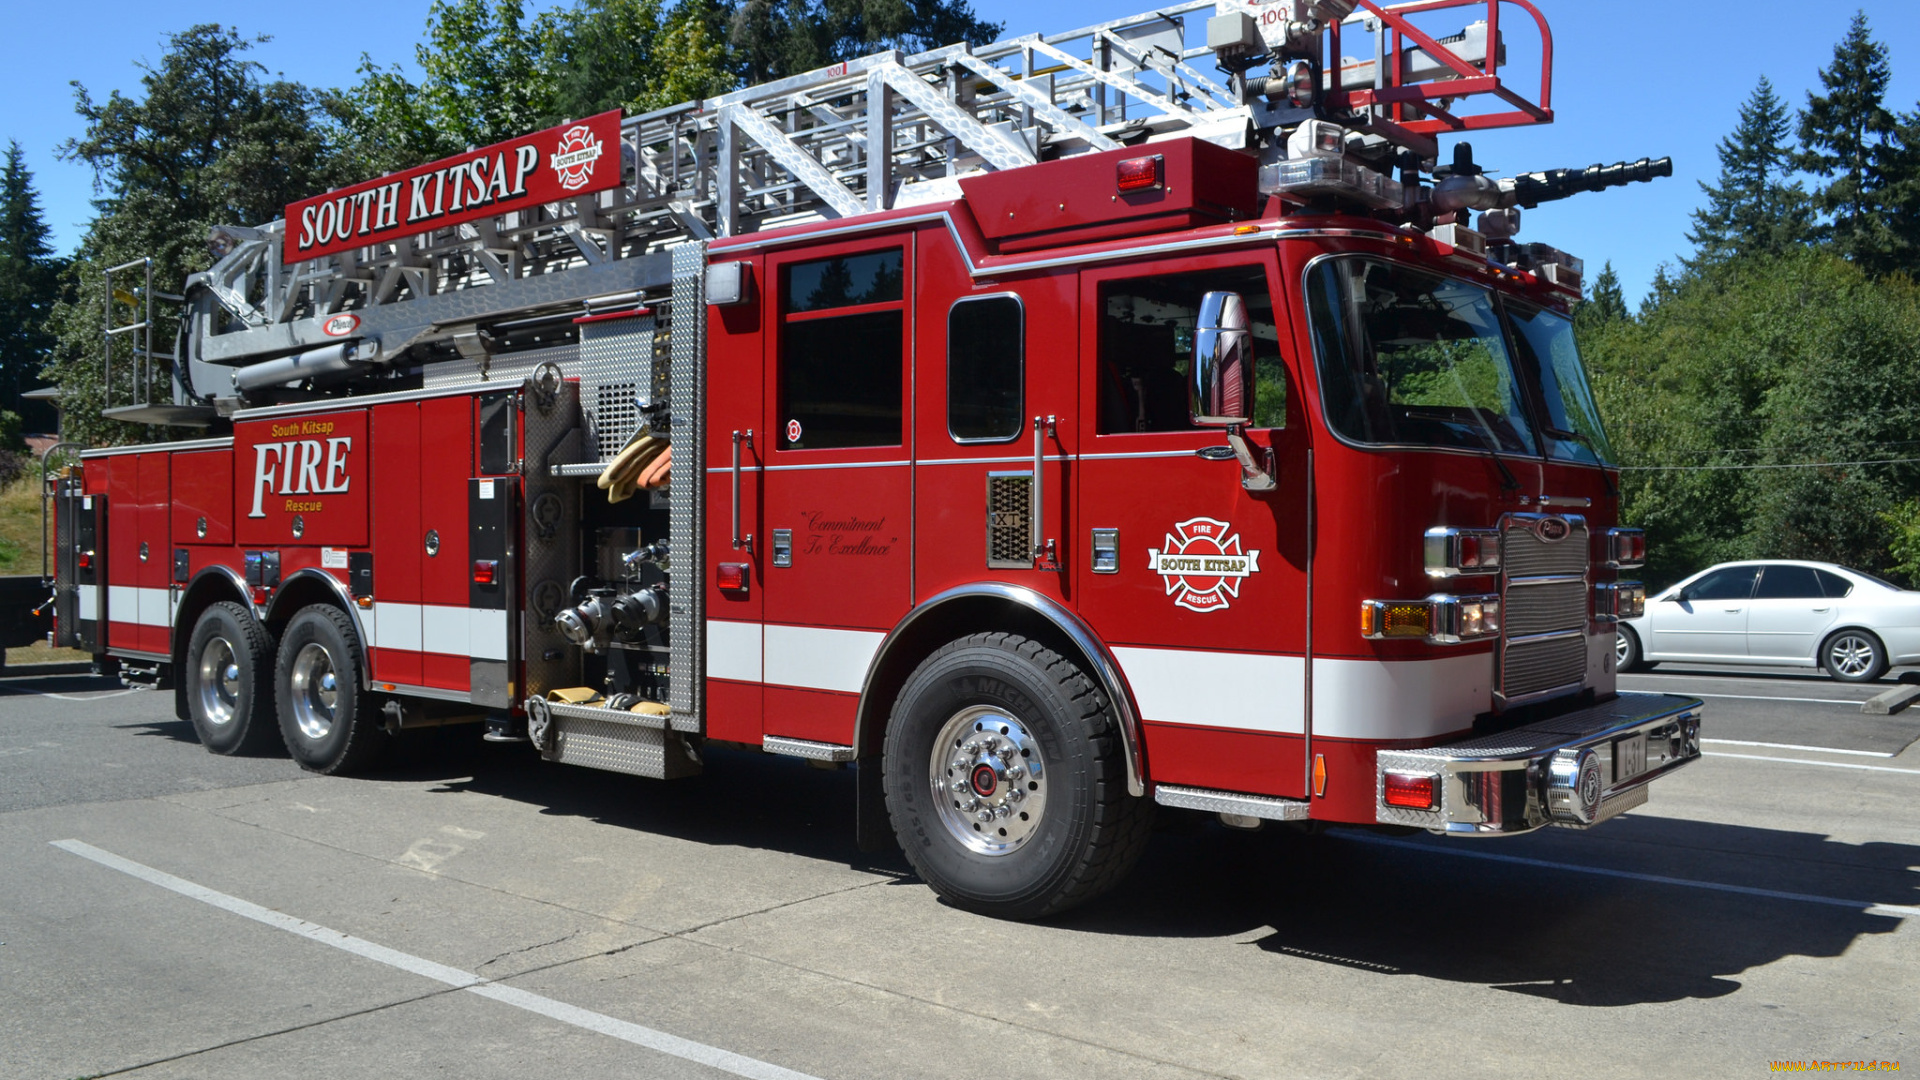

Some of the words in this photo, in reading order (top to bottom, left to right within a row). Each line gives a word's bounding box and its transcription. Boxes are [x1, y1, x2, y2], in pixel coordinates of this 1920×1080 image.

[827, 66, 841, 77] 100
[557, 155, 575, 167] SOUTH
[299, 181, 402, 250] SOUTH
[407, 144, 539, 223] KITSAP
[271, 423, 299, 437] South
[302, 421, 334, 435] Kitsap
[248, 437, 351, 518] FIRE
[285, 500, 322, 511] Rescue
[996, 513, 1019, 526] XT
[1193, 525, 1211, 534] FIRE
[803, 534, 824, 554] To
[1161, 558, 1201, 571] SOUTH
[1204, 559, 1246, 572] KITSAP
[1186, 593, 1218, 604] RESCUE
[978, 677, 1064, 761] MICHELIN
